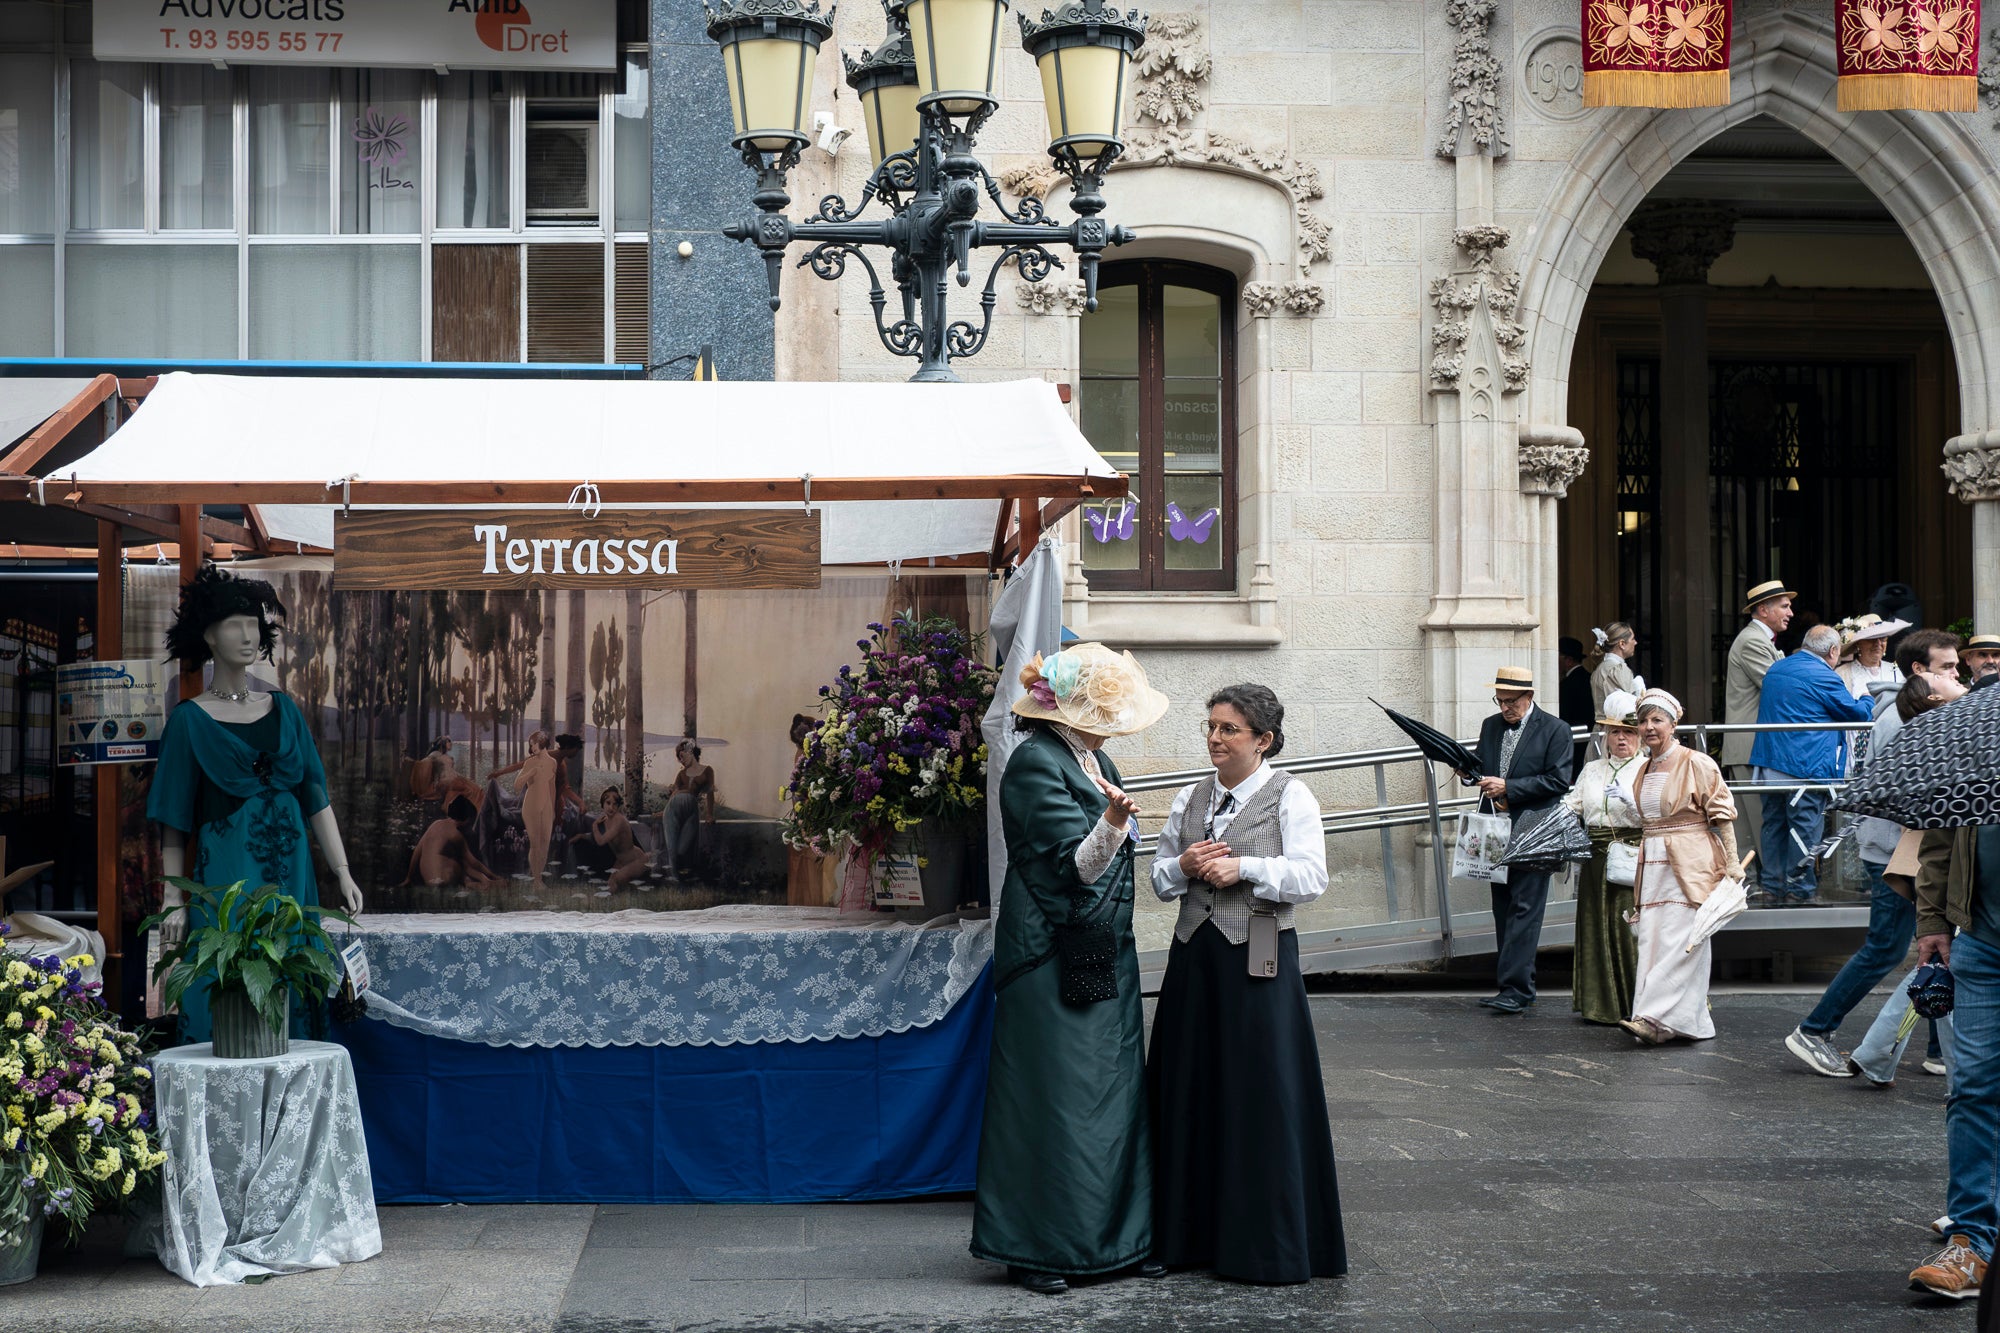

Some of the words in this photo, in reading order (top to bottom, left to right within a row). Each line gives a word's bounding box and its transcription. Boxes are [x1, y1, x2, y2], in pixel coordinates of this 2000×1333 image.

[159, 0, 345, 21] Advocats
[160, 28, 180, 48] T.
[188, 29, 218, 49] 93
[226, 30, 270, 51] 595
[278, 32, 307, 52] 55
[314, 33, 344, 52] 77
[507, 26, 569, 53] Dret
[1528, 60, 1583, 103] 190
[1171, 509, 1182, 523] 25N
[474, 524, 679, 575] Terrassa
